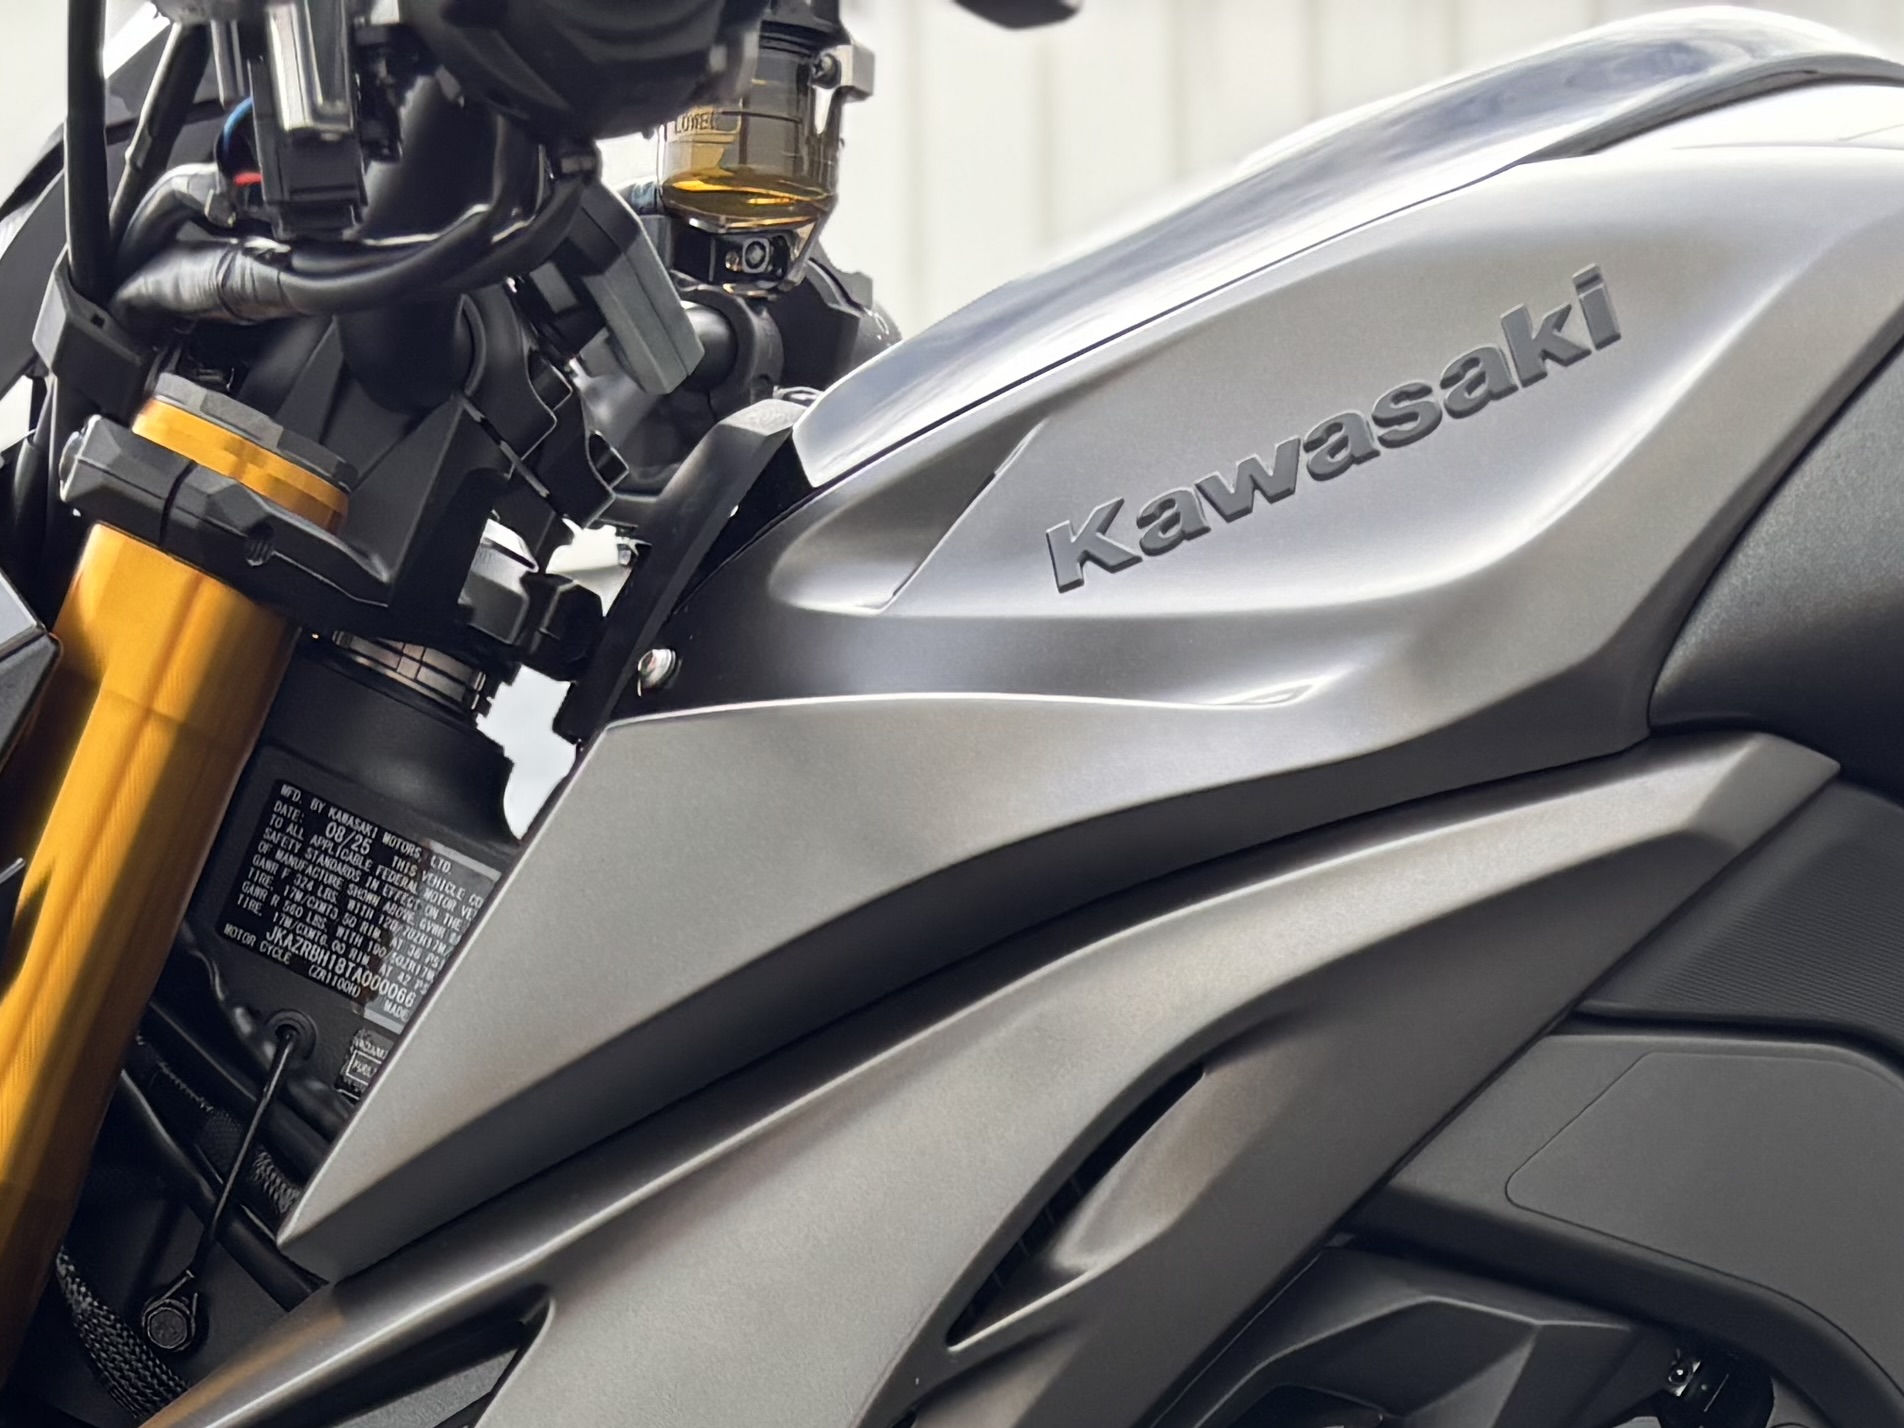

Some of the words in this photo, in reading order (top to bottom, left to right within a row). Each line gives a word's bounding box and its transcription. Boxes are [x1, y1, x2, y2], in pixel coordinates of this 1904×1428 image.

[1046, 262, 1621, 594] Kawasaki
[272, 800, 305, 824] DATE:
[322, 820, 373, 856] 08/25
[390, 855, 418, 877] THIS
[419, 870, 466, 900] VEHICLE
[308, 798, 325, 814] BY
[326, 806, 379, 839] KAWASAKI
[256, 841, 272, 856] OF
[273, 849, 344, 889] MANUFACTURE
[345, 883, 380, 907] SHOWN
[261, 827, 302, 854] SAFETY
[303, 847, 362, 883] STANDARDS
[364, 876, 380, 891] IN
[381, 883, 421, 911] EFFECT
[422, 903, 440, 920] ON
[441, 913, 462, 931] THE
[268, 814, 284, 829] TO
[285, 823, 307, 840] ALL
[308, 834, 373, 872] APPLICABLE
[374, 864, 420, 894] FEDERAL
[421, 887, 458, 912] MOTOR
[334, 925, 364, 947] WITH
[345, 899, 374, 919] WITH
[222, 922, 257, 946] MOTOR
[257, 939, 293, 964] CYCLE
[381, 999, 410, 1022] MADE
[377, 963, 393, 978] AT
[388, 936, 404, 951] AT
